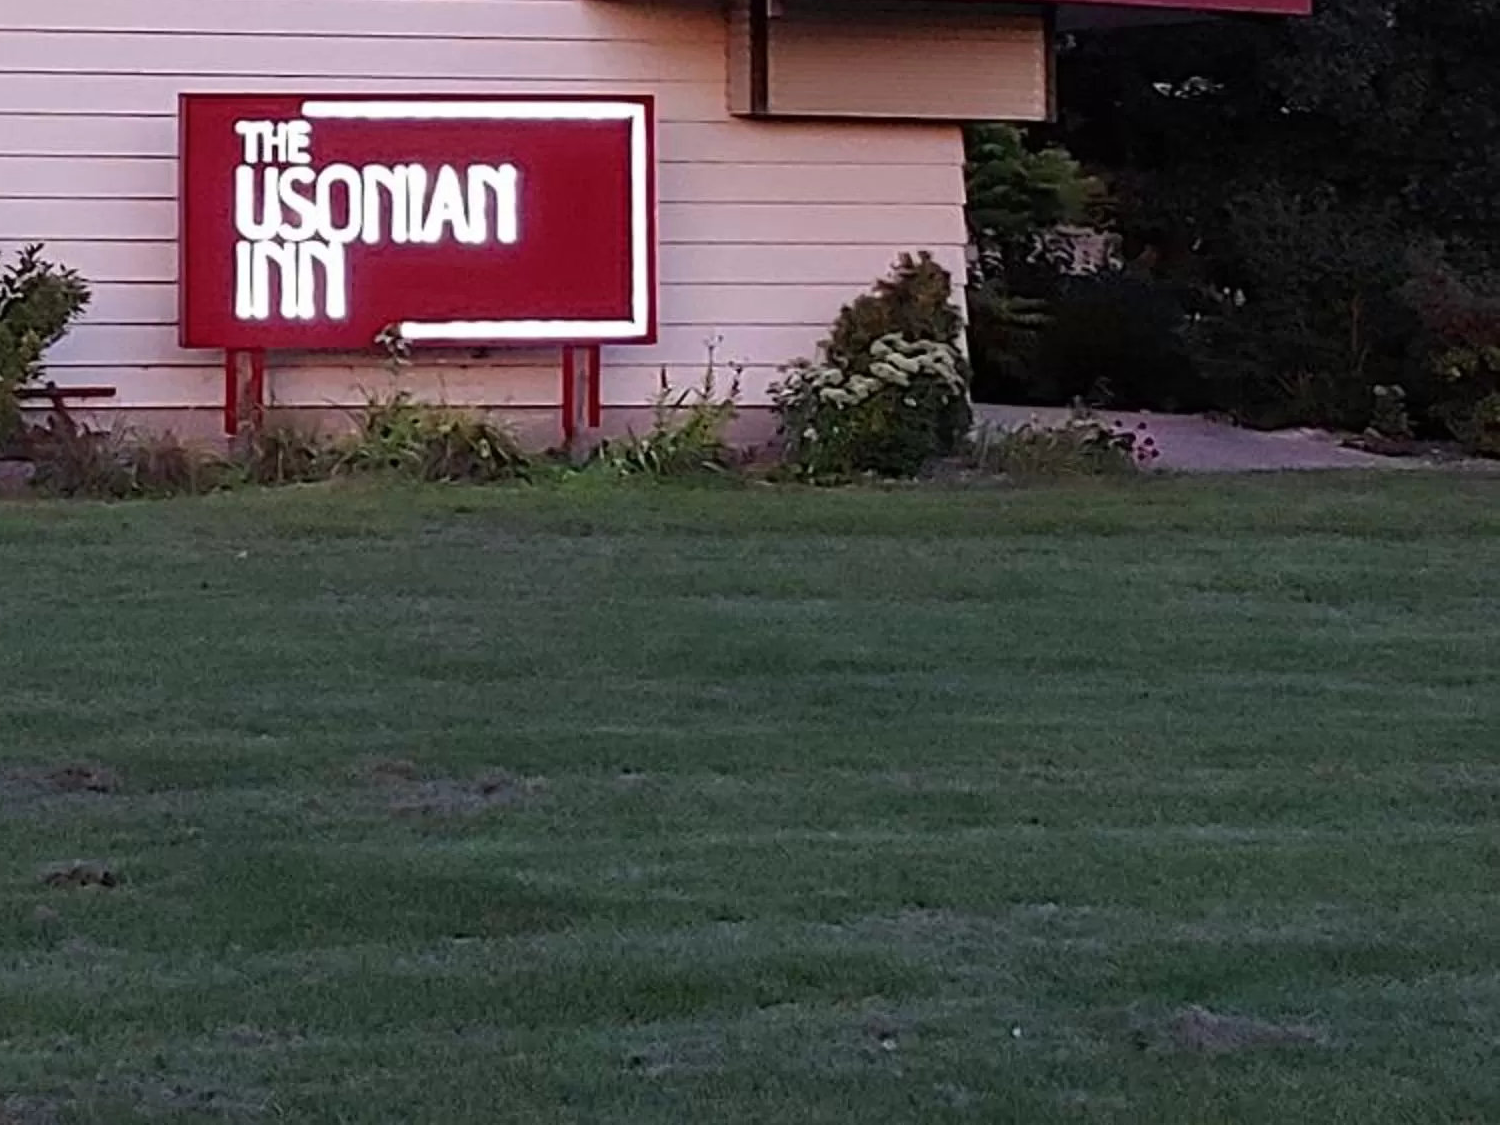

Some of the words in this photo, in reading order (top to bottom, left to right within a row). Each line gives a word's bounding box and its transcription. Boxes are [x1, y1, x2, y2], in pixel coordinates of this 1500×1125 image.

[235, 120, 312, 164] THE
[235, 163, 518, 244] USONIAN
[235, 241, 347, 320] INN
